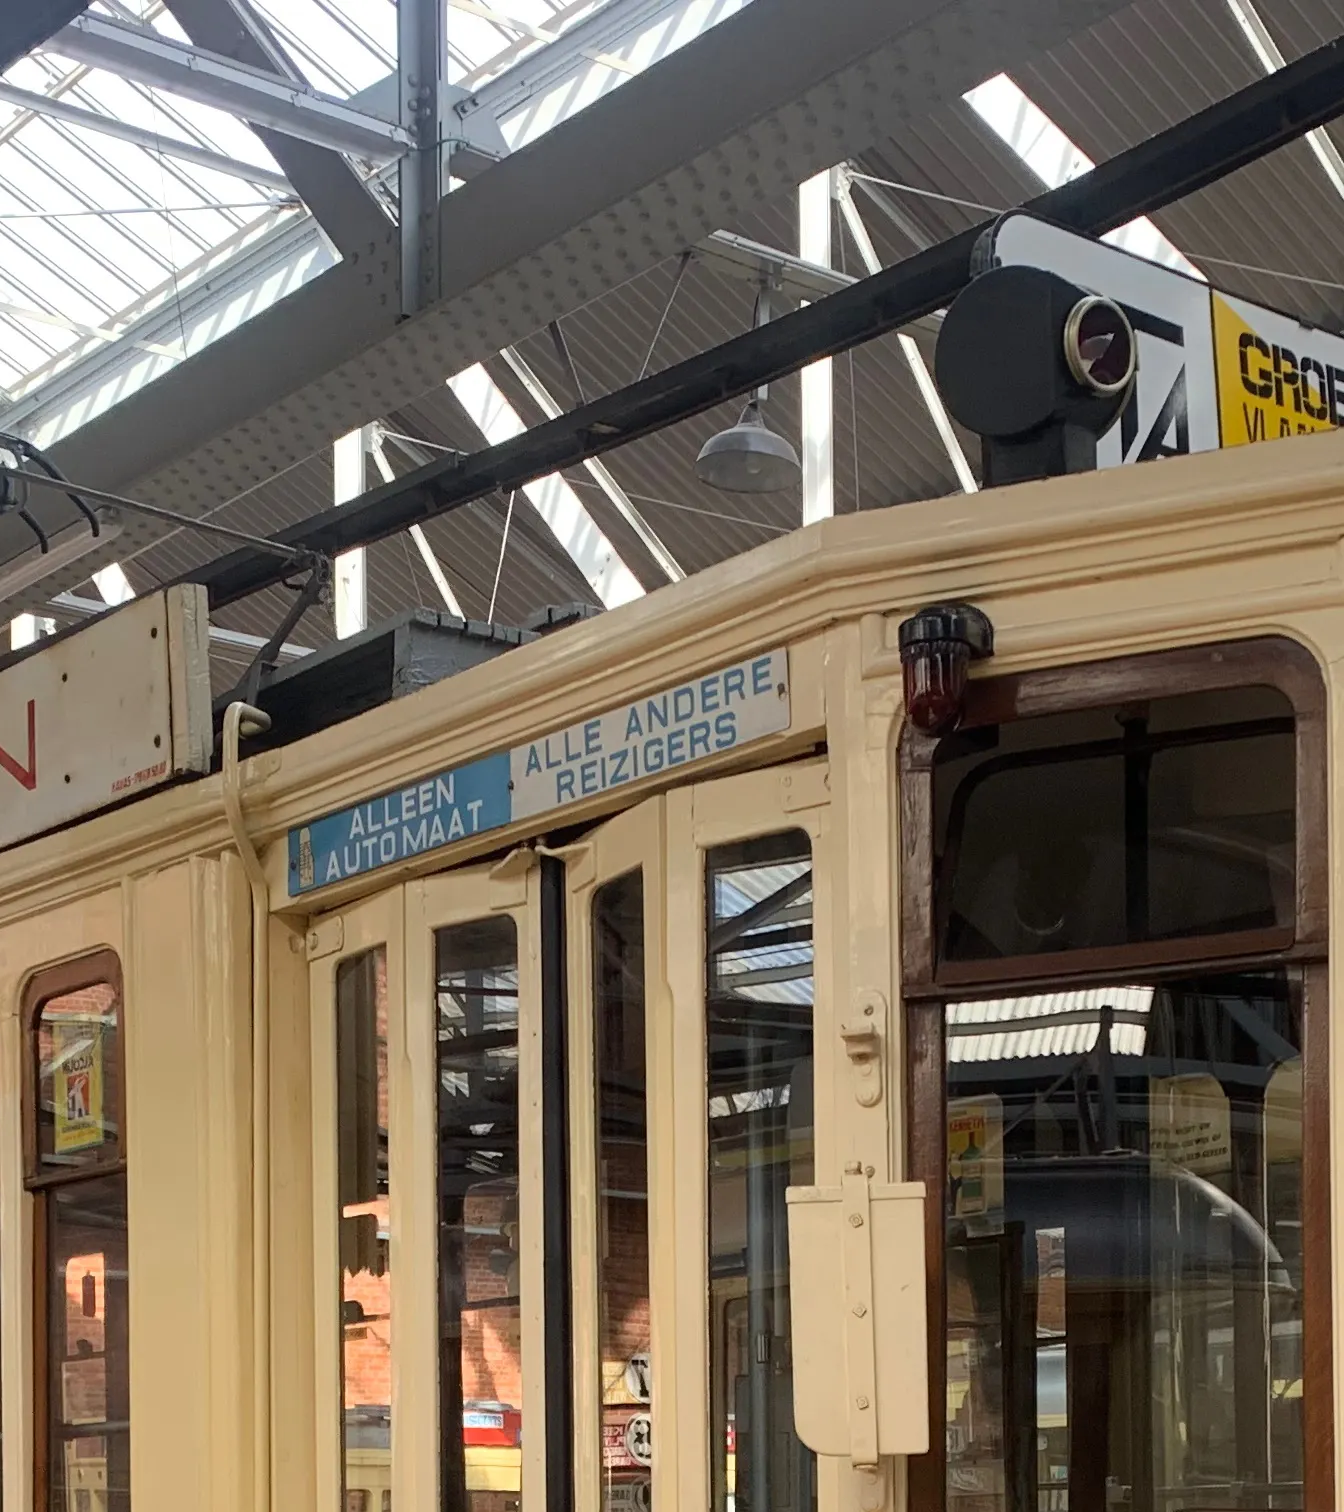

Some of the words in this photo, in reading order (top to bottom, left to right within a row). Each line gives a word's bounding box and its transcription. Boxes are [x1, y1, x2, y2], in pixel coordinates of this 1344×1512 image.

[524, 719, 603, 777] ALLE
[624, 656, 774, 742] ANDERE
[557, 712, 737, 804] REIZIGERS
[349, 773, 455, 840] ALLEEN
